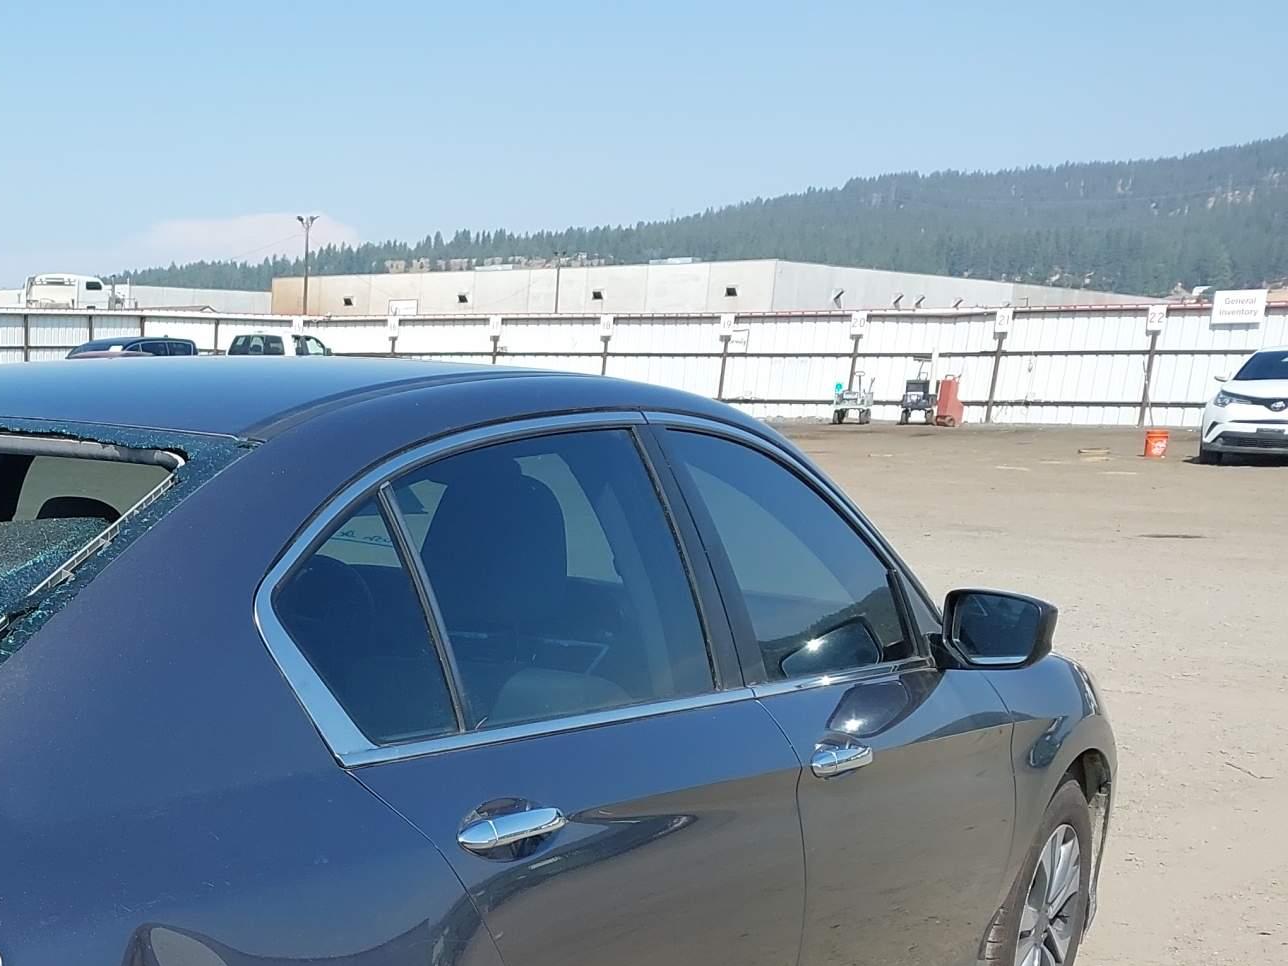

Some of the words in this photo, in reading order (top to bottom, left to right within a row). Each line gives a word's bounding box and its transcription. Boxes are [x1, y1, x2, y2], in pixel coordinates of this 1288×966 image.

[1224, 296, 1257, 305] General
[1219, 308, 1258, 317] Inventory
[1149, 311, 1164, 324] 22
